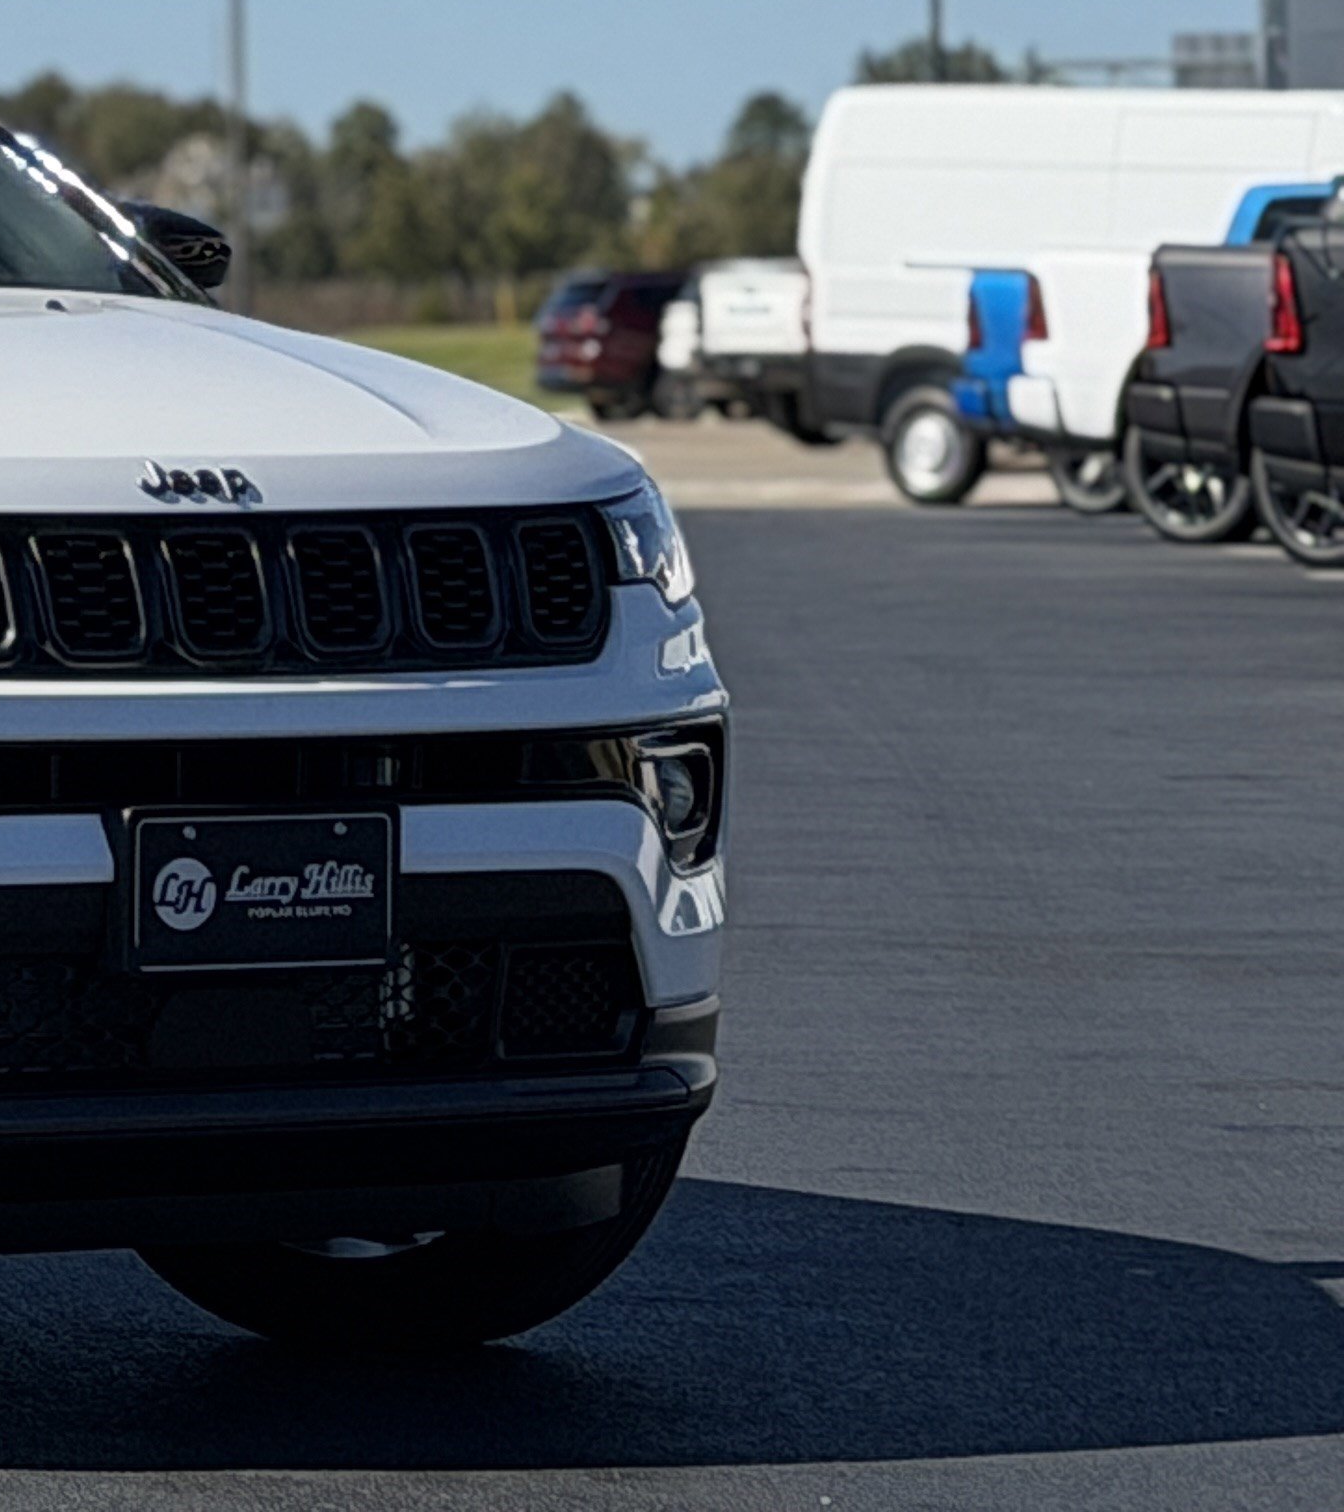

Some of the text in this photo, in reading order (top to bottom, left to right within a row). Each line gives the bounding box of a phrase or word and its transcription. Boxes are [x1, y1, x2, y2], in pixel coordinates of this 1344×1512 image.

[138, 460, 263, 507] Jeep
[224, 859, 376, 905] Larry Hillis
